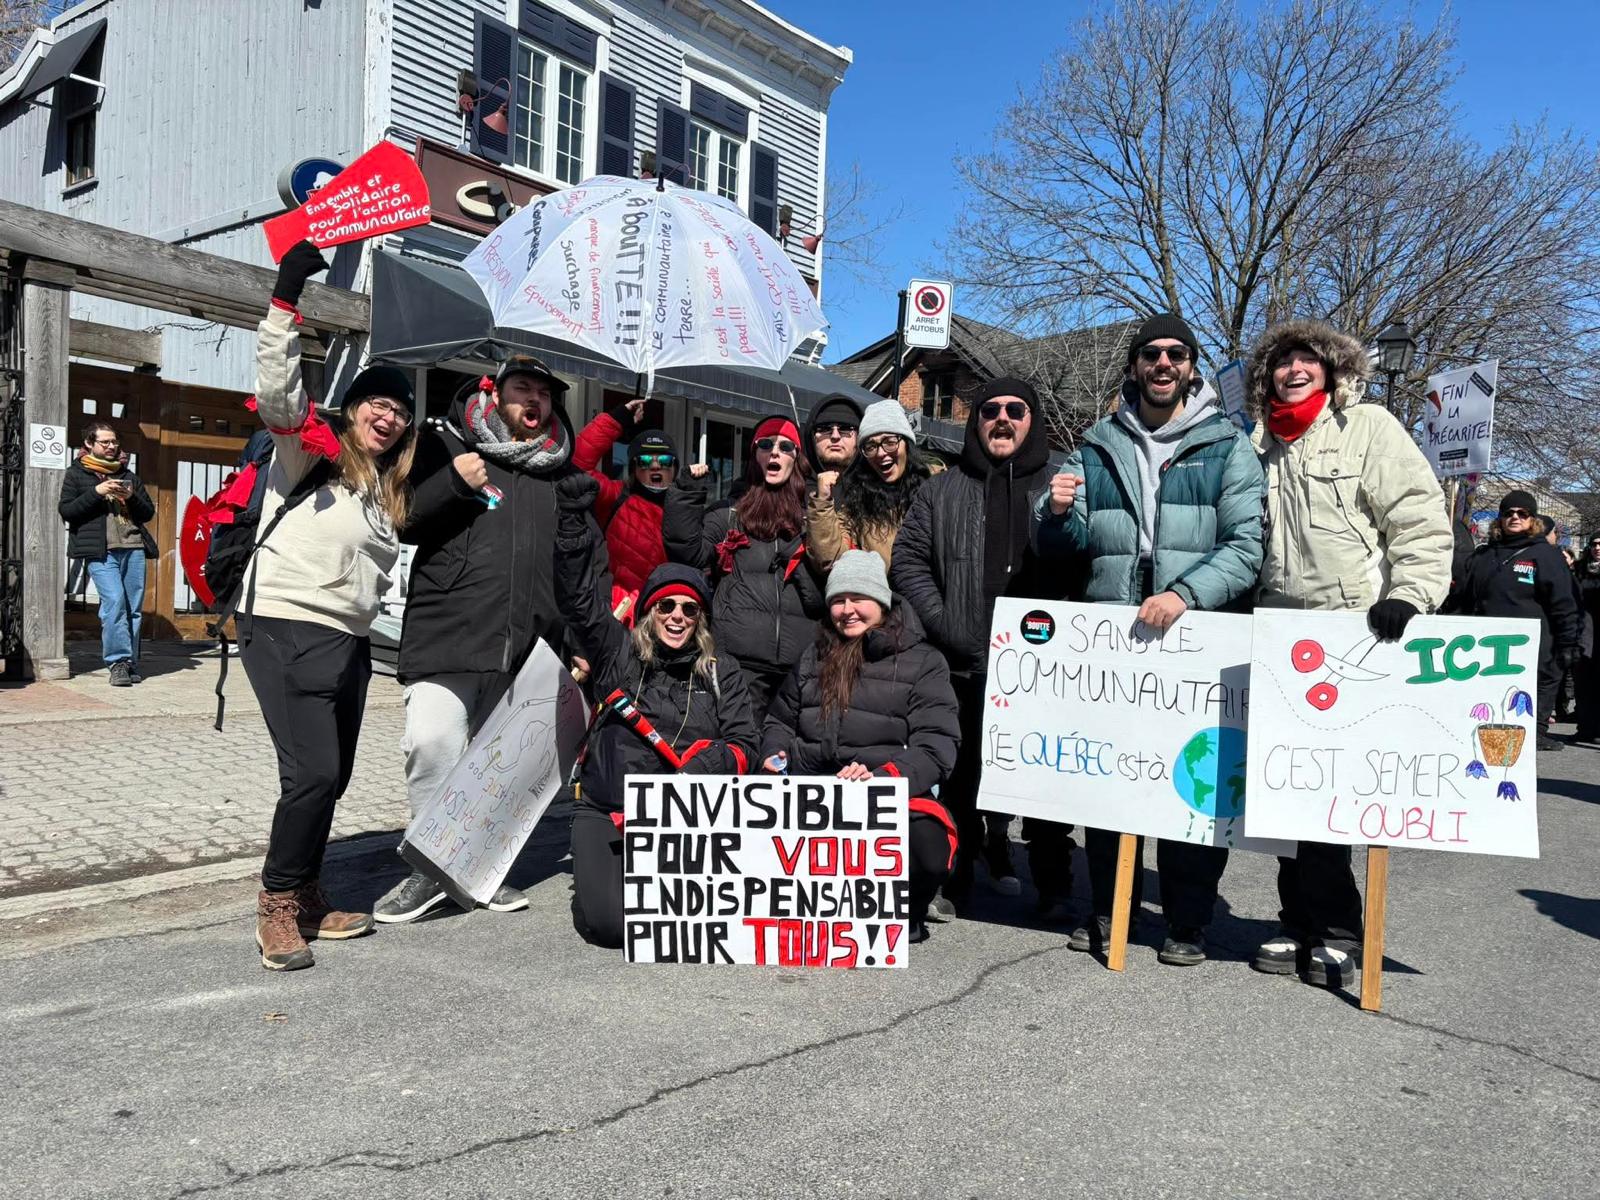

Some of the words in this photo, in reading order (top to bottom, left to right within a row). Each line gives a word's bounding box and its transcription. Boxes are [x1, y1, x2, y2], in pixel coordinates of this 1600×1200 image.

[306, 185, 360, 216] Ensemble
[368, 174, 382, 187] et
[315, 205, 431, 242] communautaire
[910, 325, 944, 333] AUTOBUS
[1448, 407, 1460, 419] LA
[1068, 614, 1149, 654] SANS
[1159, 626, 1204, 653] LE
[1404, 634, 1530, 684] ICI
[996, 648, 1249, 720] COMMUNAUTAIR
[1020, 731, 1113, 776] QUÉBEC
[1264, 744, 1344, 791] C'EST
[1353, 749, 1466, 799] SEMER
[1328, 796, 1469, 842] L'OUBLI
[626, 832, 741, 874] POUR
[772, 836, 902, 876] VOUS
[627, 921, 735, 964] POUR
